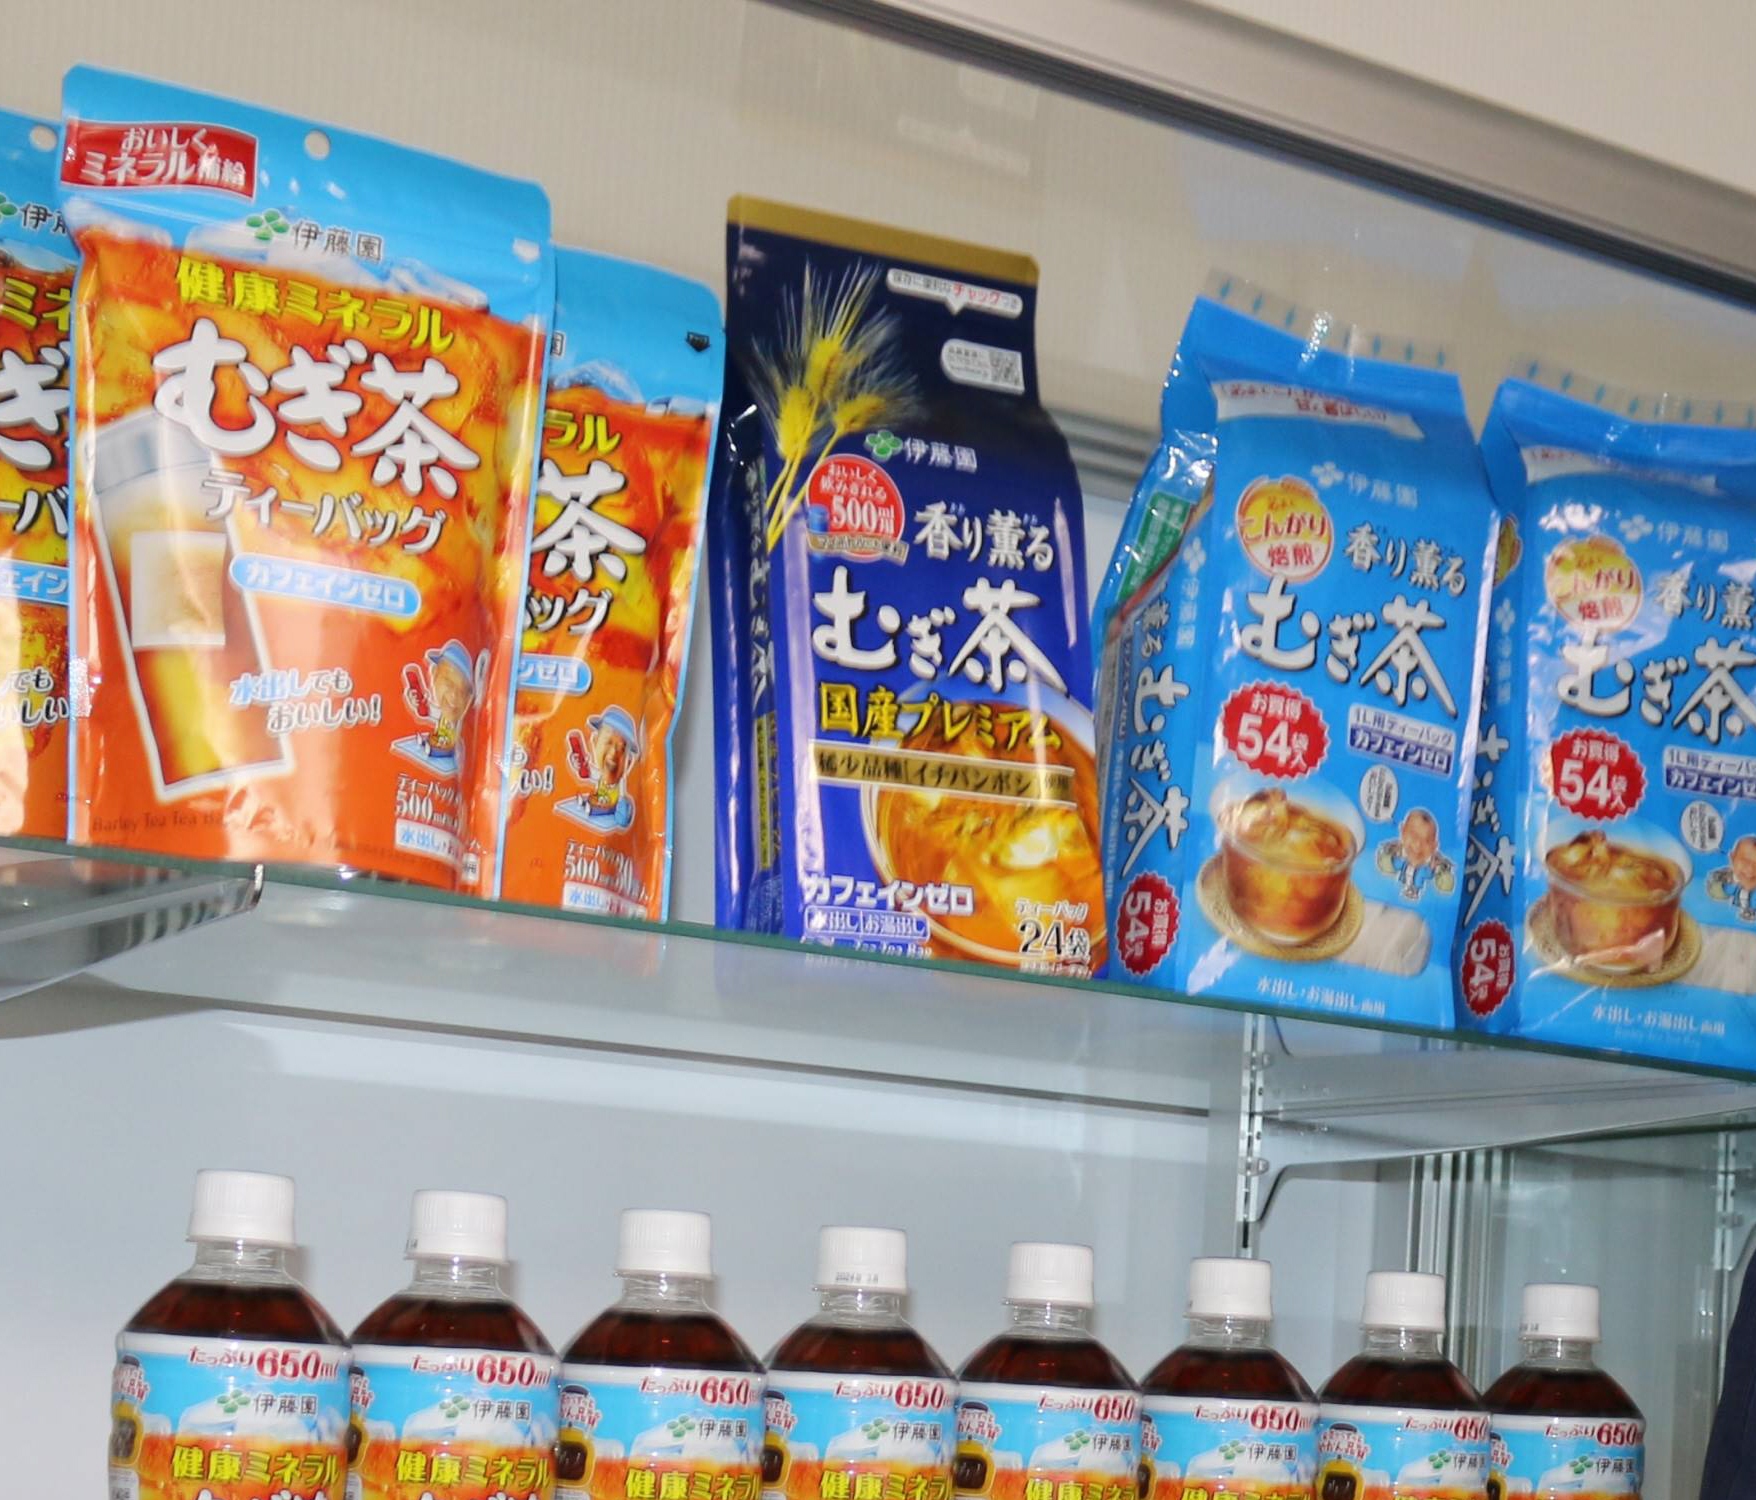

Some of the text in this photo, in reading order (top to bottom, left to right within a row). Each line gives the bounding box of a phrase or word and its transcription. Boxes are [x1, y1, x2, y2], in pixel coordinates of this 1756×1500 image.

[122, 128, 207, 150] おいしく
[292, 220, 383, 261] 伊藤園
[176, 258, 455, 353] 健康ミネラル
[153, 318, 480, 497] むぎ茶
[903, 436, 977, 472] 伊藤園
[1350, 473, 1419, 509] 伊藤園
[202, 467, 446, 554] ティーバッグ
[532, 457, 648, 582] 茶
[1242, 512, 1327, 541] こんがり
[915, 500, 1055, 570] 香り薫る
[1657, 521, 1729, 551] 伊藤園
[1268, 547, 1316, 568] 焙煎
[1344, 522, 1466, 597] 香り薫る
[246, 558, 407, 610] カフェインゼロ
[811, 565, 1069, 694] むぎ茶
[1240, 571, 1458, 718] むぎ茶
[230, 668, 352, 705] 水出しでも
[1251, 691, 1302, 718] お買得
[267, 696, 382, 734] おいしい!
[819, 682, 1063, 752] 国産プレミアム
[1236, 715, 1310, 772] 54袋入
[1354, 733, 1451, 772] カフェインゼロ
[1571, 738, 1620, 763] お買得
[1121, 664, 1190, 878] むぎ茶
[1559, 759, 1629, 811] 54袋入
[803, 875, 975, 915] カフェインゼロ
[1018, 918, 1091, 960] 24袋
[188, 1345, 340, 1381] たっぷり650ml
[411, 1354, 552, 1388] たっぷり650ml
[255, 1393, 317, 1416] 伊藤園
[472, 1400, 531, 1421] 伊藤園
[700, 1419, 748, 1441] 伊藤園
[892, 1421, 942, 1442] 伊藤園
[1092, 1434, 1132, 1451] 伊藤園
[172, 1445, 340, 1490] 健康ミネラル
[395, 1450, 550, 1489] 健康ミネラル
[1249, 1443, 1297, 1462] 伊藤園
[1595, 1457, 1636, 1474] 伊藤園
